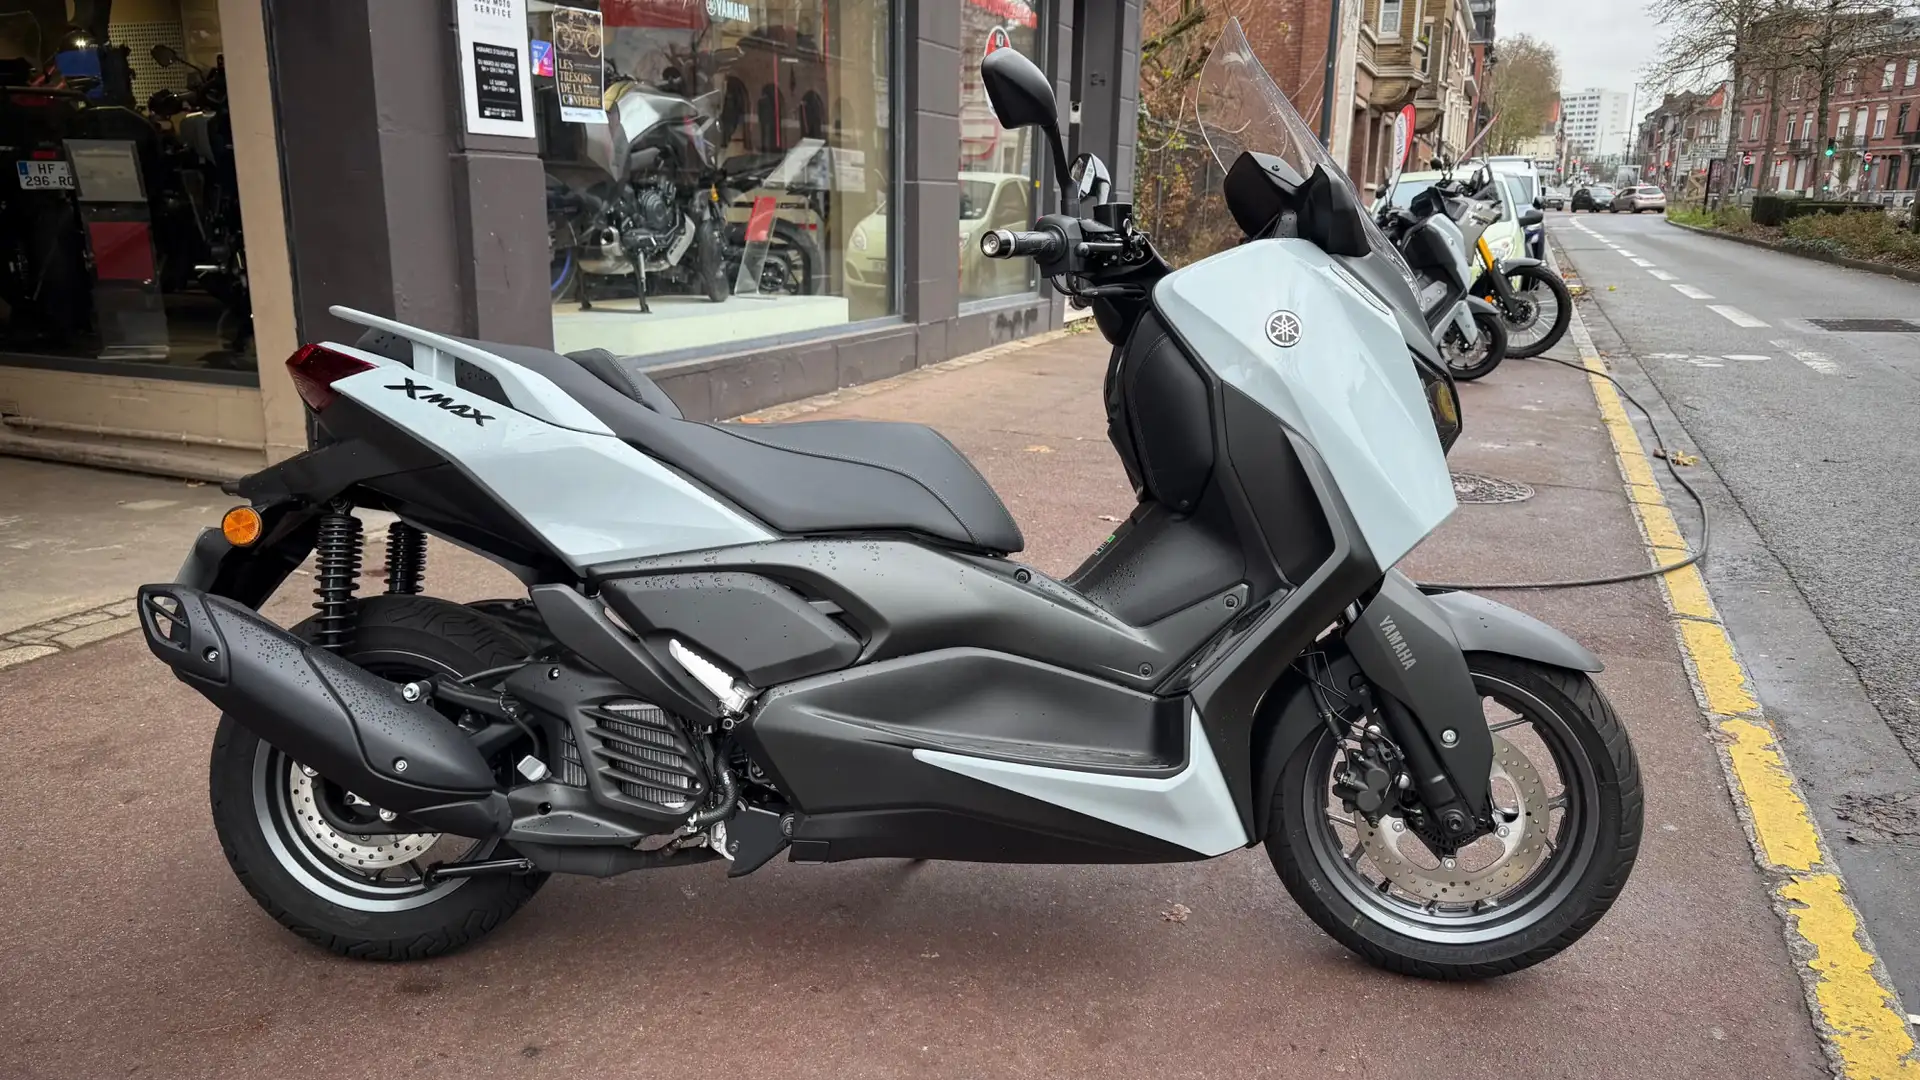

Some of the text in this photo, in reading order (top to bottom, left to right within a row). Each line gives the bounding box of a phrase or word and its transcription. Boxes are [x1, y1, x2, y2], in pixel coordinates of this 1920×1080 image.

[474, 4, 511, 18] SERVICE
[717, 1, 750, 22] YAMAHA
[559, 58, 574, 69] LES
[560, 82, 572, 93] DE
[573, 83, 583, 94] LA
[1379, 614, 1417, 671] YAMAHA
